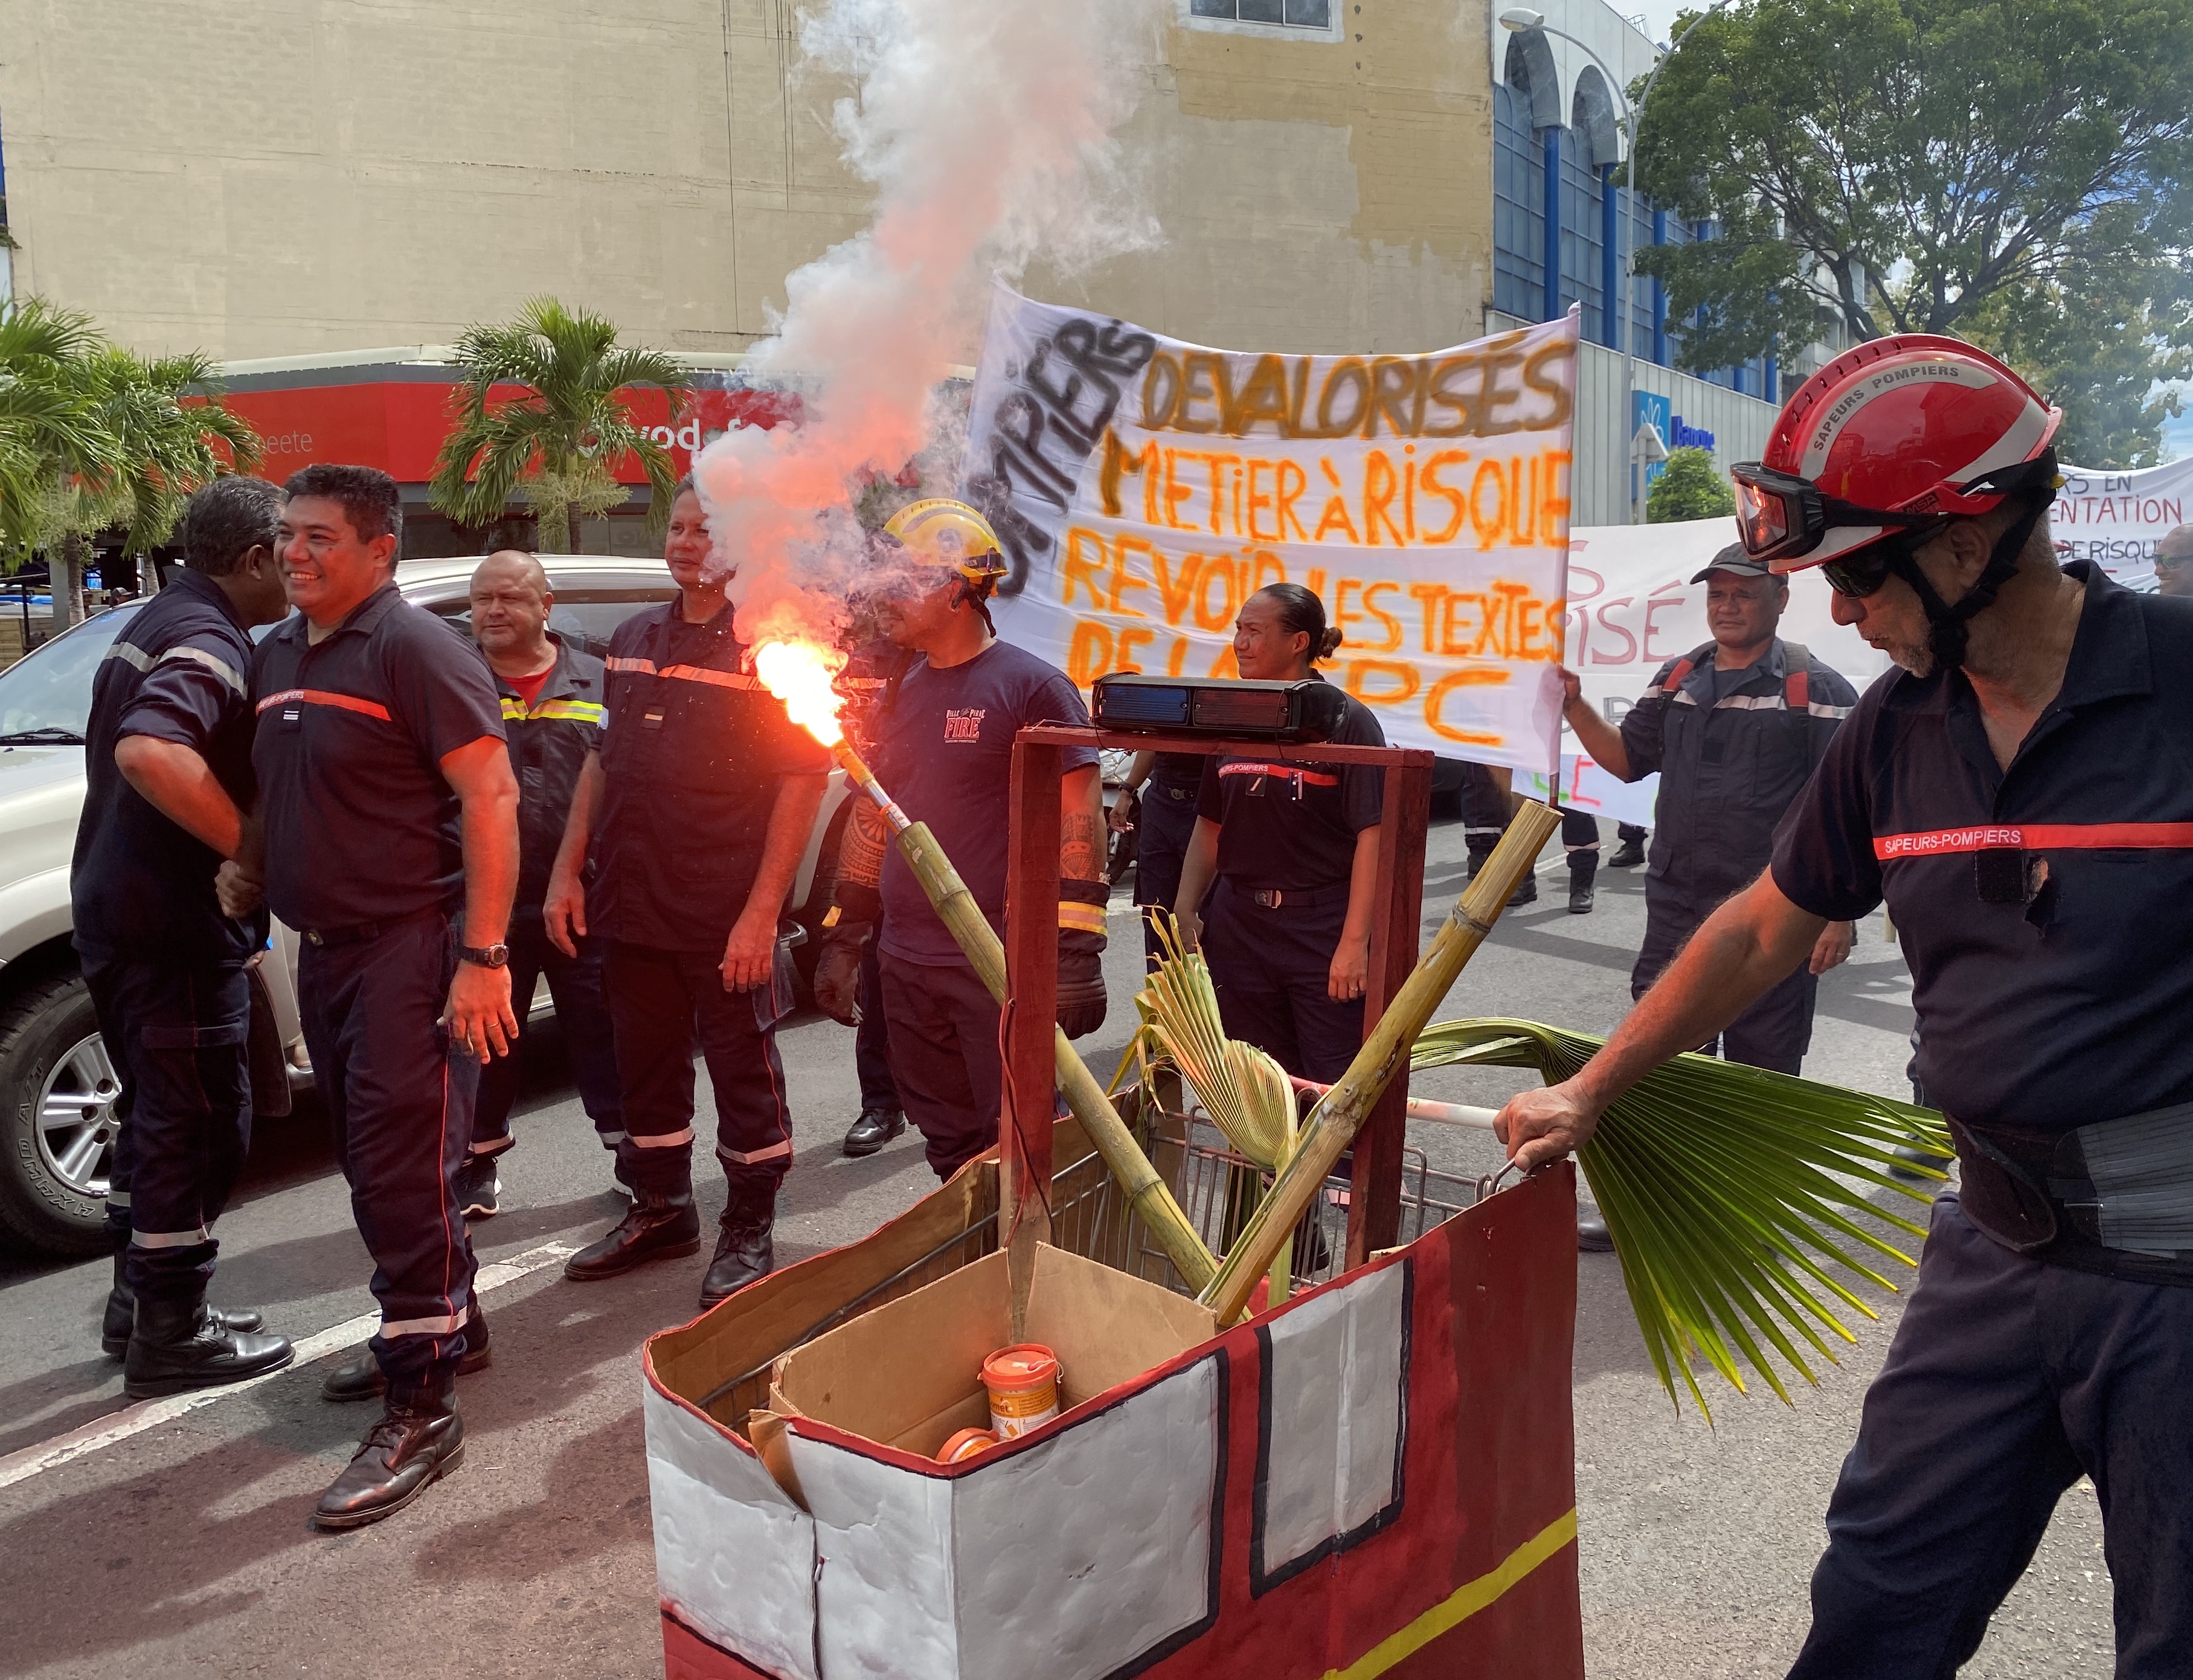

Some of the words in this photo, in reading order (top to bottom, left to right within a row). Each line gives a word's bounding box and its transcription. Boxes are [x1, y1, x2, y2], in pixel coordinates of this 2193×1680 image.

[1814, 389, 1865, 451] SAPEURS
[1872, 365, 1960, 389] POMPIERS
[2104, 474, 2133, 492] EN
[1408, 580, 1568, 663] TEXTES
[1565, 579, 1686, 667] ISÉ
[944, 717, 981, 738] FIRE
[1885, 829, 2021, 854] SAPEURS-POMPIERS
